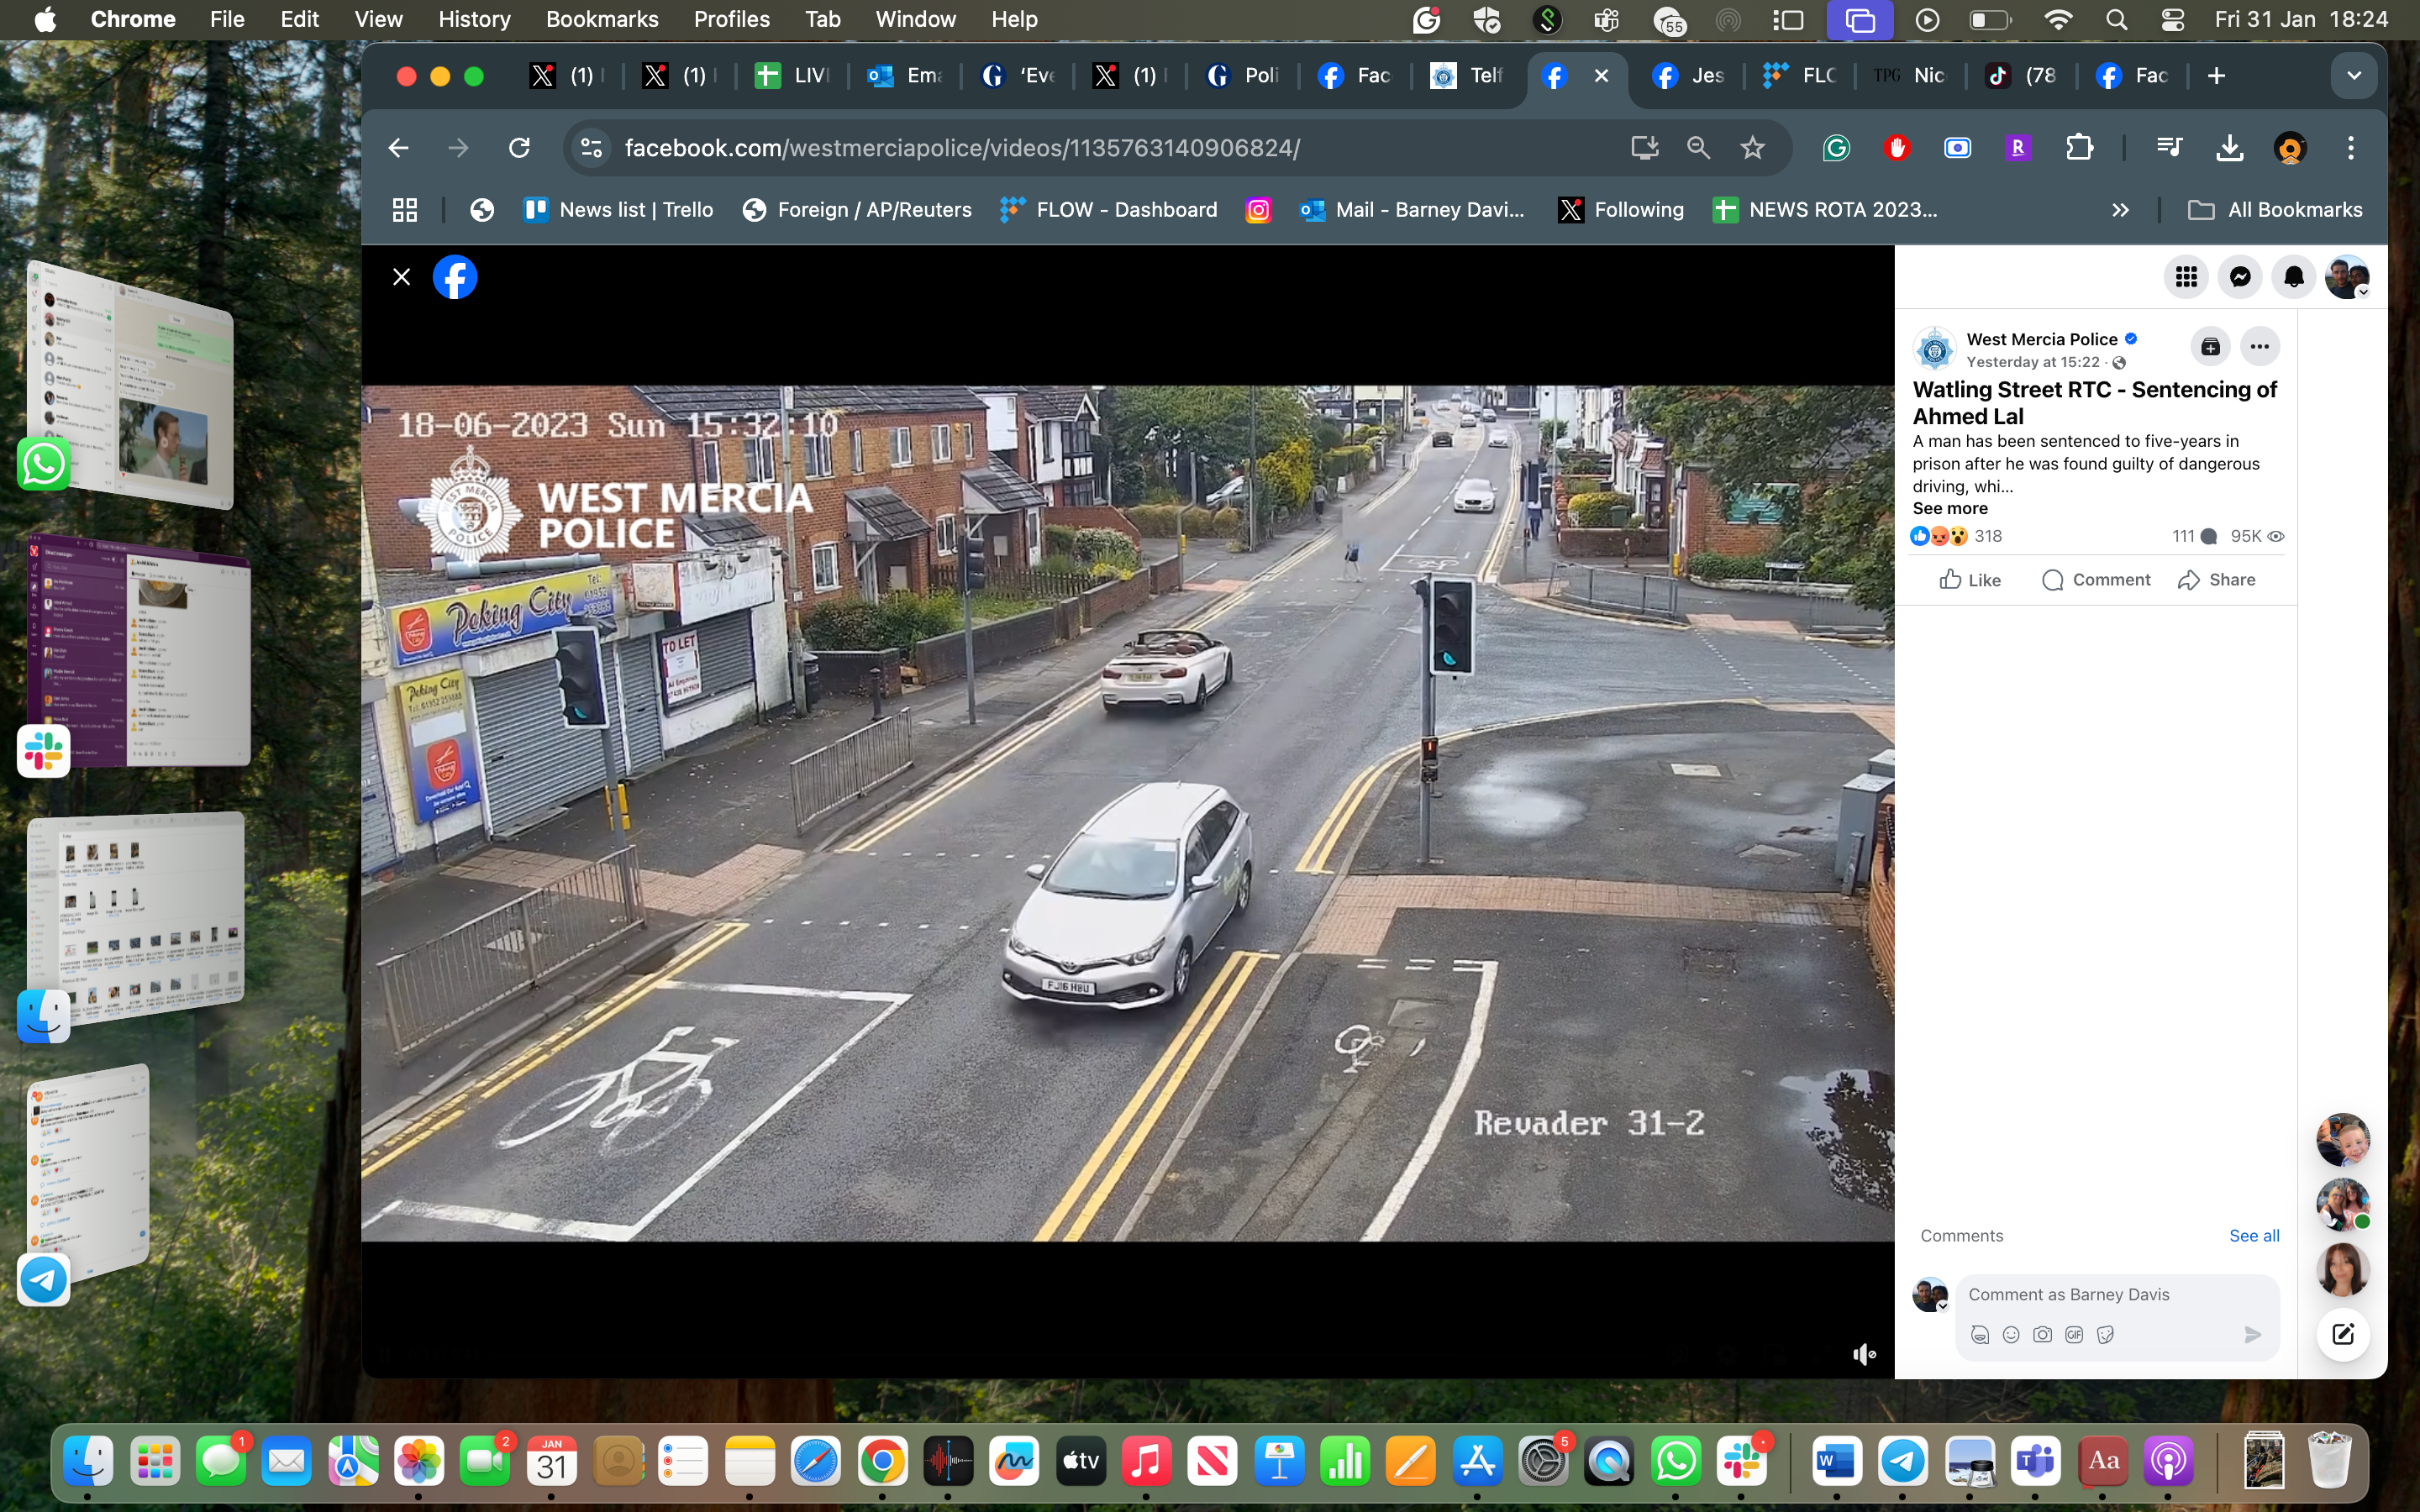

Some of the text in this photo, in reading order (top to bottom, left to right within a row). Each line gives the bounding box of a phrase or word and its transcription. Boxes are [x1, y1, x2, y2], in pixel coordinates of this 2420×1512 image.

[92, 10, 176, 28] Chrome
[212, 10, 245, 27] File
[282, 10, 319, 27] Edit
[355, 10, 403, 27] View
[440, 10, 511, 31] History
[548, 10, 659, 27] Bookmarks
[696, 10, 770, 27] Profiles
[806, 10, 841, 27] Tab
[876, 10, 956, 27] Window
[993, 10, 1038, 31] Help
[2217, 10, 2388, 27] Fri 31 Jan 18:24
[1666, 22, 1683, 33] 55
[571, 67, 592, 87] (1)
[684, 67, 705, 87] (1)
[1134, 67, 1155, 87] (1)
[1693, 67, 1723, 83] Jes
[1874, 68, 1900, 81] TPG
[625, 139, 1301, 160] facebook.com/westmerciapolice/videos/1135763140906824/
[561, 202, 612, 217] News
[619, 202, 645, 217] list
[663, 202, 713, 217] Trello
[780, 202, 971, 221] Foreign / AP/Reuters
[1039, 202, 1093, 218] FLOW
[1116, 202, 1217, 217] Dashboard
[1338, 202, 1373, 217] Mail
[1397, 202, 1461, 221] Barney
[1468, 202, 1523, 217] Davi...
[1597, 202, 1683, 221] Following
[1751, 202, 1937, 218] NEWS ROTA 2023...
[2228, 202, 2363, 217] All Bookmarks
[1967, 333, 2118, 345] West Mercia Police
[1967, 356, 2099, 370] Yesterday at 15:22
[1913, 380, 1991, 402] Watling
[1998, 381, 2062, 398] Street
[2069, 381, 2111, 398] RTC
[2133, 380, 2250, 402] Sentencing
[2257, 381, 2278, 398] of
[1913, 407, 2023, 425] Ahmed Lal
[1913, 434, 2238, 450] A man has been sentenced to five-years in
[1914, 457, 2260, 473] prison after he was found guilty of dangerous
[1913, 480, 2012, 496] driving, whi...
[1913, 501, 1988, 515] See more
[1975, 530, 2002, 542] 318
[2173, 530, 2193, 542] 111
[2232, 530, 2262, 542] 95K
[588, 575, 602, 585] Tel:
[1970, 574, 2001, 586] Like
[2074, 573, 2151, 585] Comment
[2211, 573, 2255, 585] Share
[446, 586, 573, 647] Peking City
[662, 635, 695, 654] TO LET
[407, 677, 459, 702] Peking City
[1922, 1230, 2003, 1242] Comments
[2230, 1229, 2279, 1242] See all
[1970, 1288, 2170, 1304] Comment as Barney Davis
[2068, 1331, 2081, 1339] GIF
[239, 1436, 244, 1446] 1
[502, 1436, 509, 1446] 2
[542, 1440, 562, 1448] JAN
[1561, 1436, 1569, 1446] 5
[538, 1455, 564, 1478] 31
[2089, 1451, 2120, 1469] Aa
